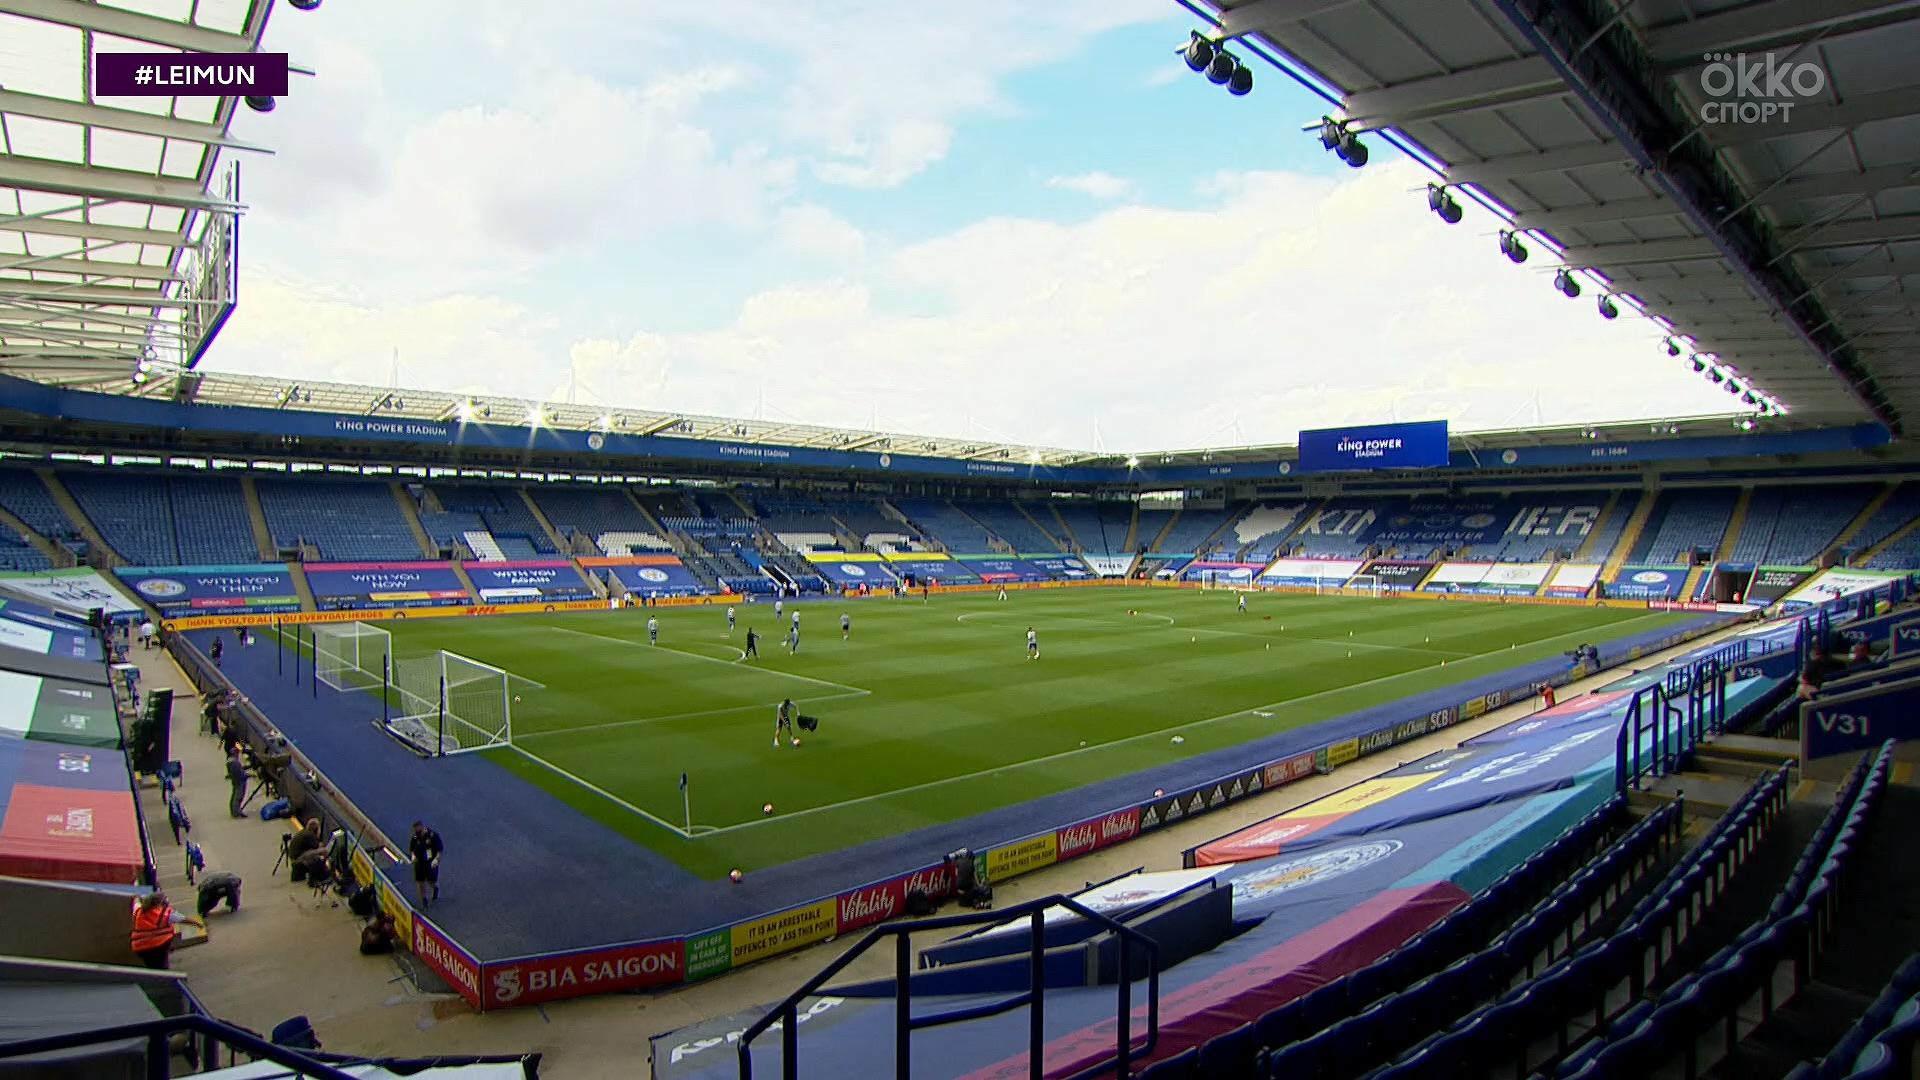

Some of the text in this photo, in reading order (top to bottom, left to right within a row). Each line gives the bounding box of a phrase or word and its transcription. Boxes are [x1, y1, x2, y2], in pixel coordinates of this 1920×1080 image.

[335, 420, 448, 436] KING POWER STADIUM
[719, 446, 790, 458] KING POWER STADIUM
[1337, 438, 1402, 452] KING POWER
[1355, 449, 1384, 458] STADIUM
[1376, 530, 1485, 541] AND FOREVER
[197, 576, 280, 585] WITH YOU
[351, 573, 421, 582] WITH YOU
[528, 569, 557, 577] YOU
[219, 585, 264, 593] THEN
[371, 581, 408, 589] NOW
[187, 618, 216, 628] THANK
[218, 617, 240, 626] YOU
[242, 617, 256, 626] TO
[278, 615, 298, 624] YOU
[299, 613, 346, 623] EVERYDAY
[348, 611, 384, 620] HEROES
[1486, 692, 1501, 711] SCB
[1430, 710, 1449, 731] SCB
[1817, 712, 1870, 736] V31
[1102, 812, 1136, 839] Vitality
[1059, 824, 1097, 854] Vitality
[841, 888, 895, 924] Vitality
[749, 908, 821, 939] IT IS AN ARRESTABLE
[734, 938, 767, 957] OFFENCE
[768, 935, 778, 947] TO
[798, 924, 814, 938] THIS
[814, 918, 834, 933] POINT
[425, 935, 479, 995] BIA SAIGON
[529, 951, 677, 992] BIA SAIGON
